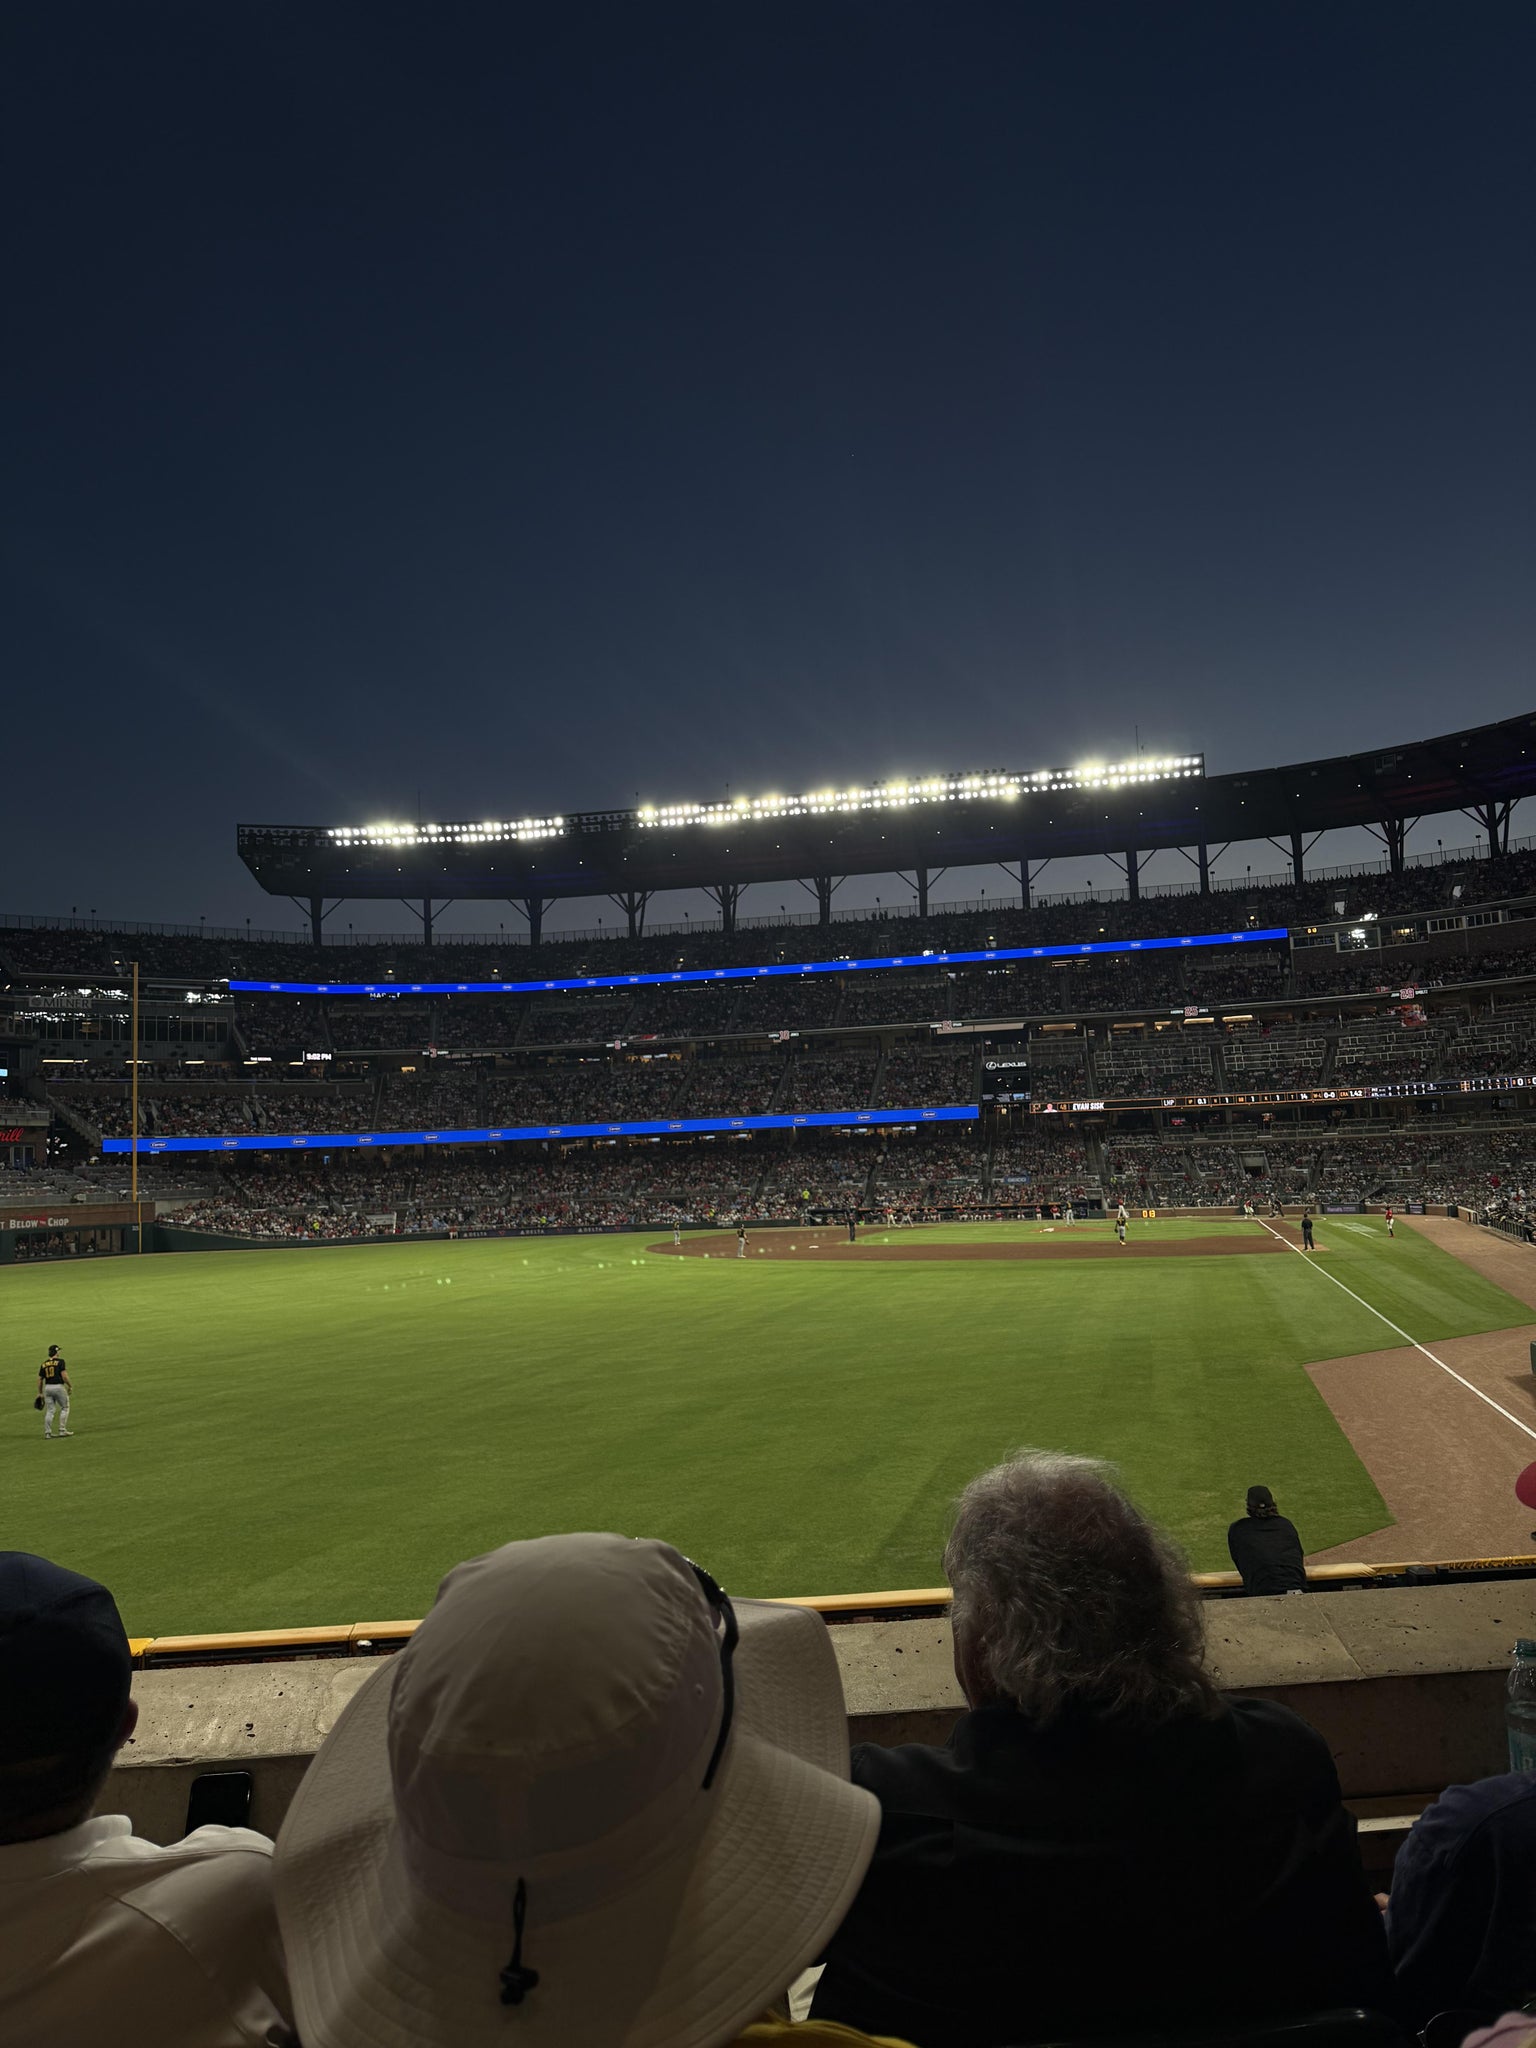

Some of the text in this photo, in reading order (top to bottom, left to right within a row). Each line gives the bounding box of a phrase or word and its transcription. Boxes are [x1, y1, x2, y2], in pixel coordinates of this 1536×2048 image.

[43, 998, 90, 1009] MILNER
[1517, 1078, 1523, 1086] 0
[9, 1220, 38, 1229] BELOW
[47, 1217, 70, 1227] CHOP
